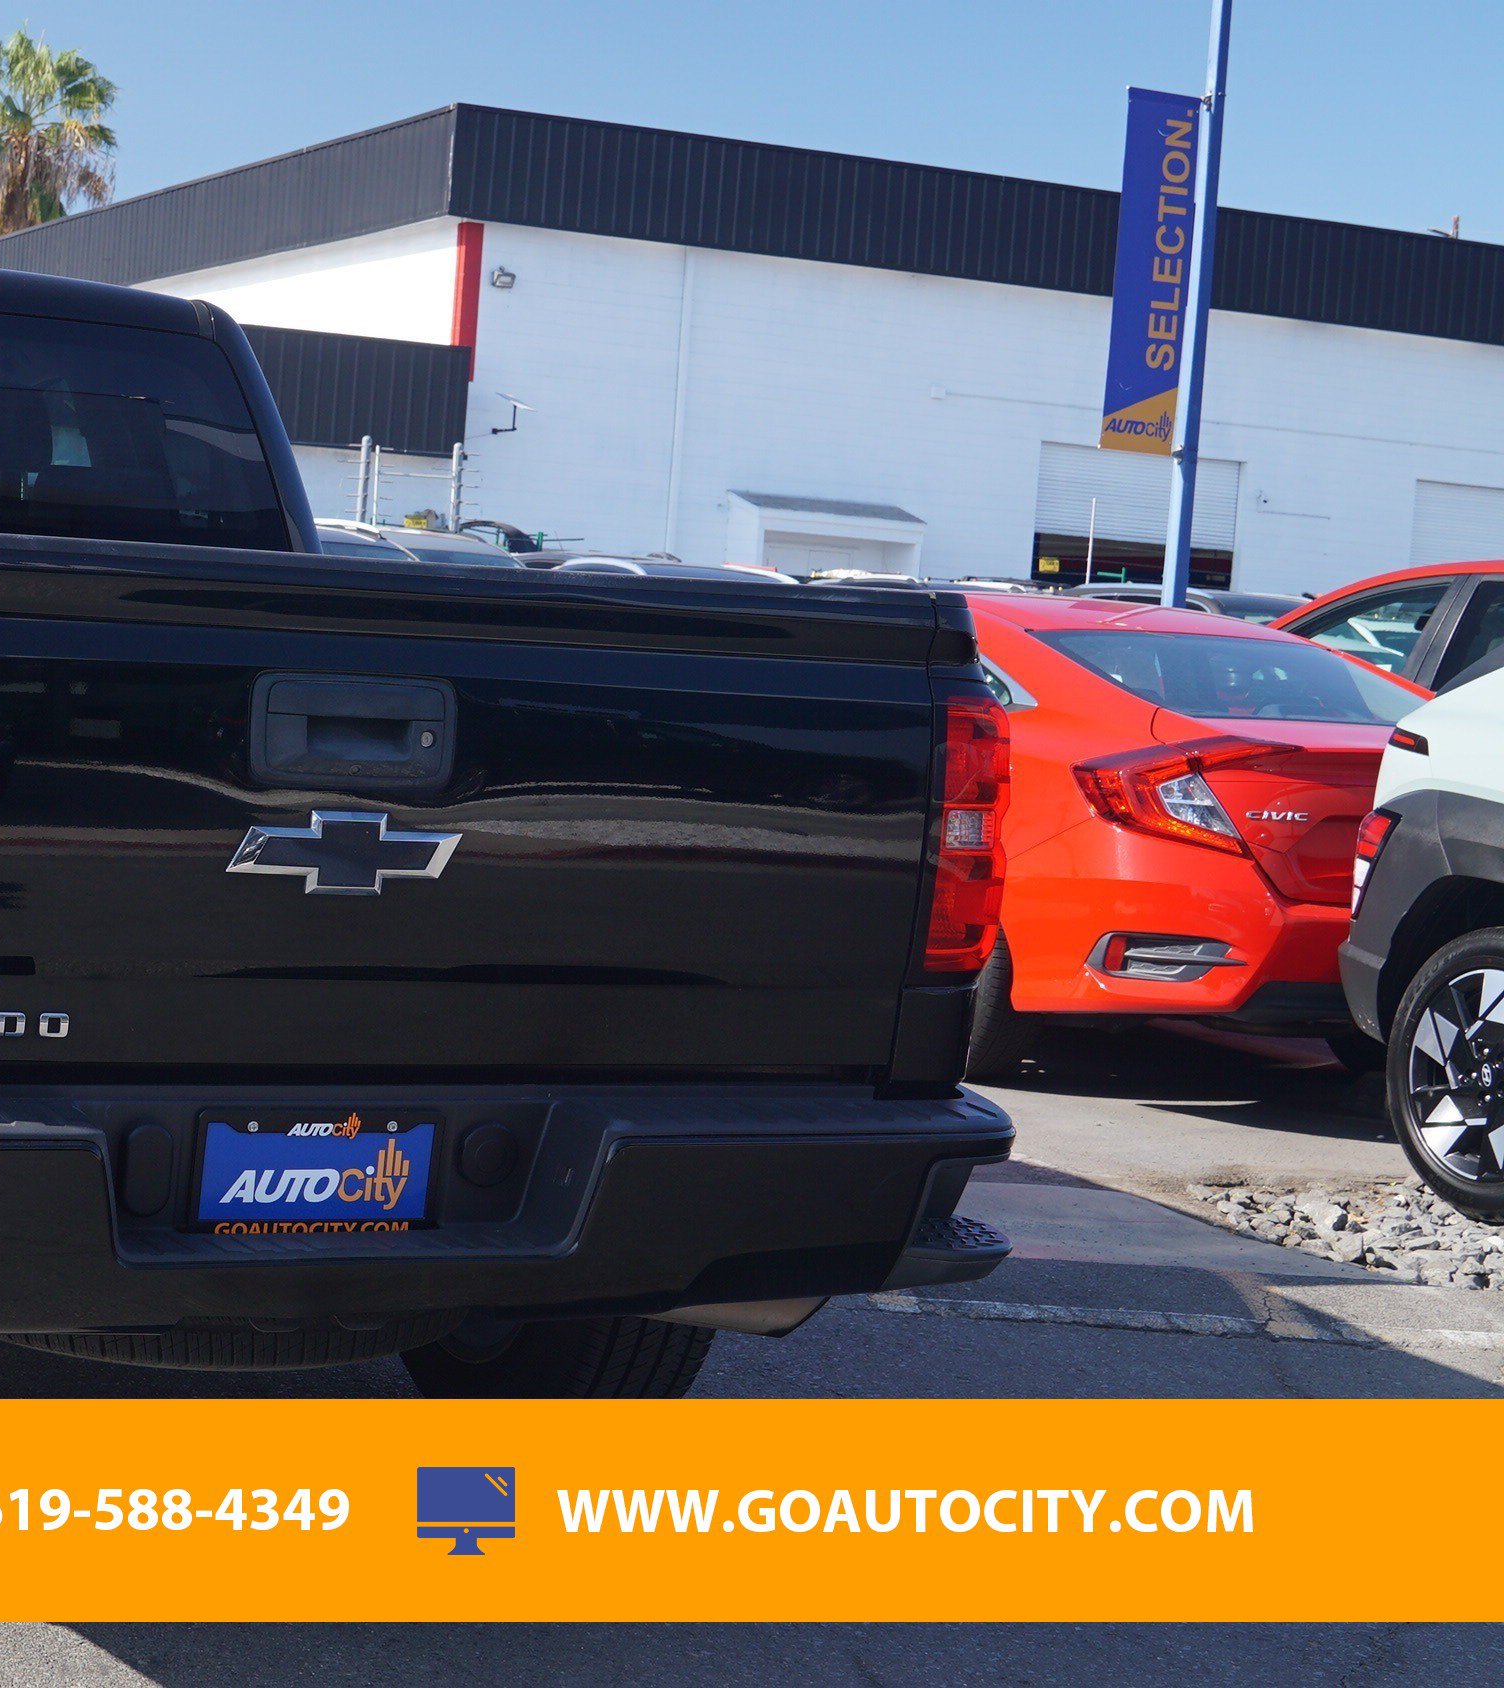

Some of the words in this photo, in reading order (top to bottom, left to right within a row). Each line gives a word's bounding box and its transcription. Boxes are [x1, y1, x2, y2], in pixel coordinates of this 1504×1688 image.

[1146, 109, 1194, 371] SELECTION.
[1245, 810, 1309, 822] CIVIC
[219, 1145, 408, 1210] AUTOCity
